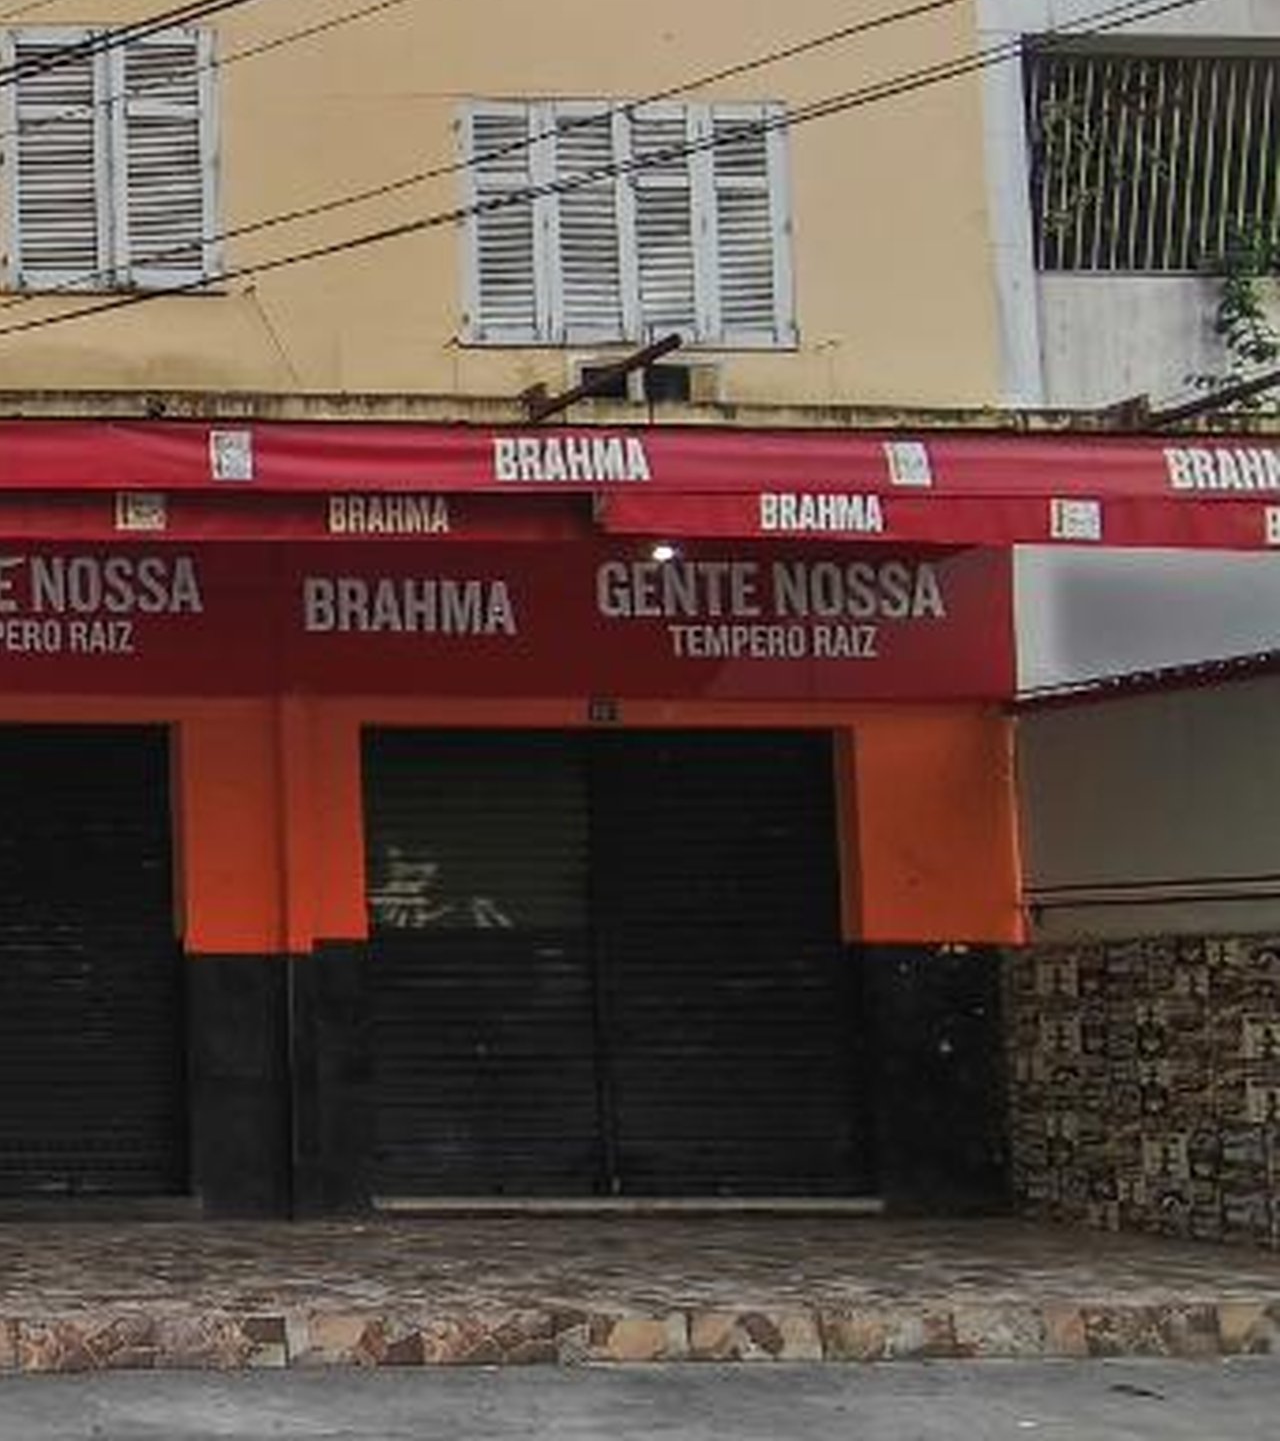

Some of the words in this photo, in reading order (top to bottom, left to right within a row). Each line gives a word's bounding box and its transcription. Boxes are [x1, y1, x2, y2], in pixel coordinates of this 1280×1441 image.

[493, 437, 651, 481] BRAHMA
[328, 496, 450, 534] BRAHMA
[760, 494, 883, 534] BRAHMA
[31, 558, 203, 614] NOSSA
[596, 561, 760, 619] GENTE
[774, 562, 945, 619] NOSSA
[303, 578, 518, 637] BRAHMA
[69, 620, 134, 653] RAIZ
[668, 624, 806, 658] TEMPERO
[813, 625, 879, 659] RAIZ
